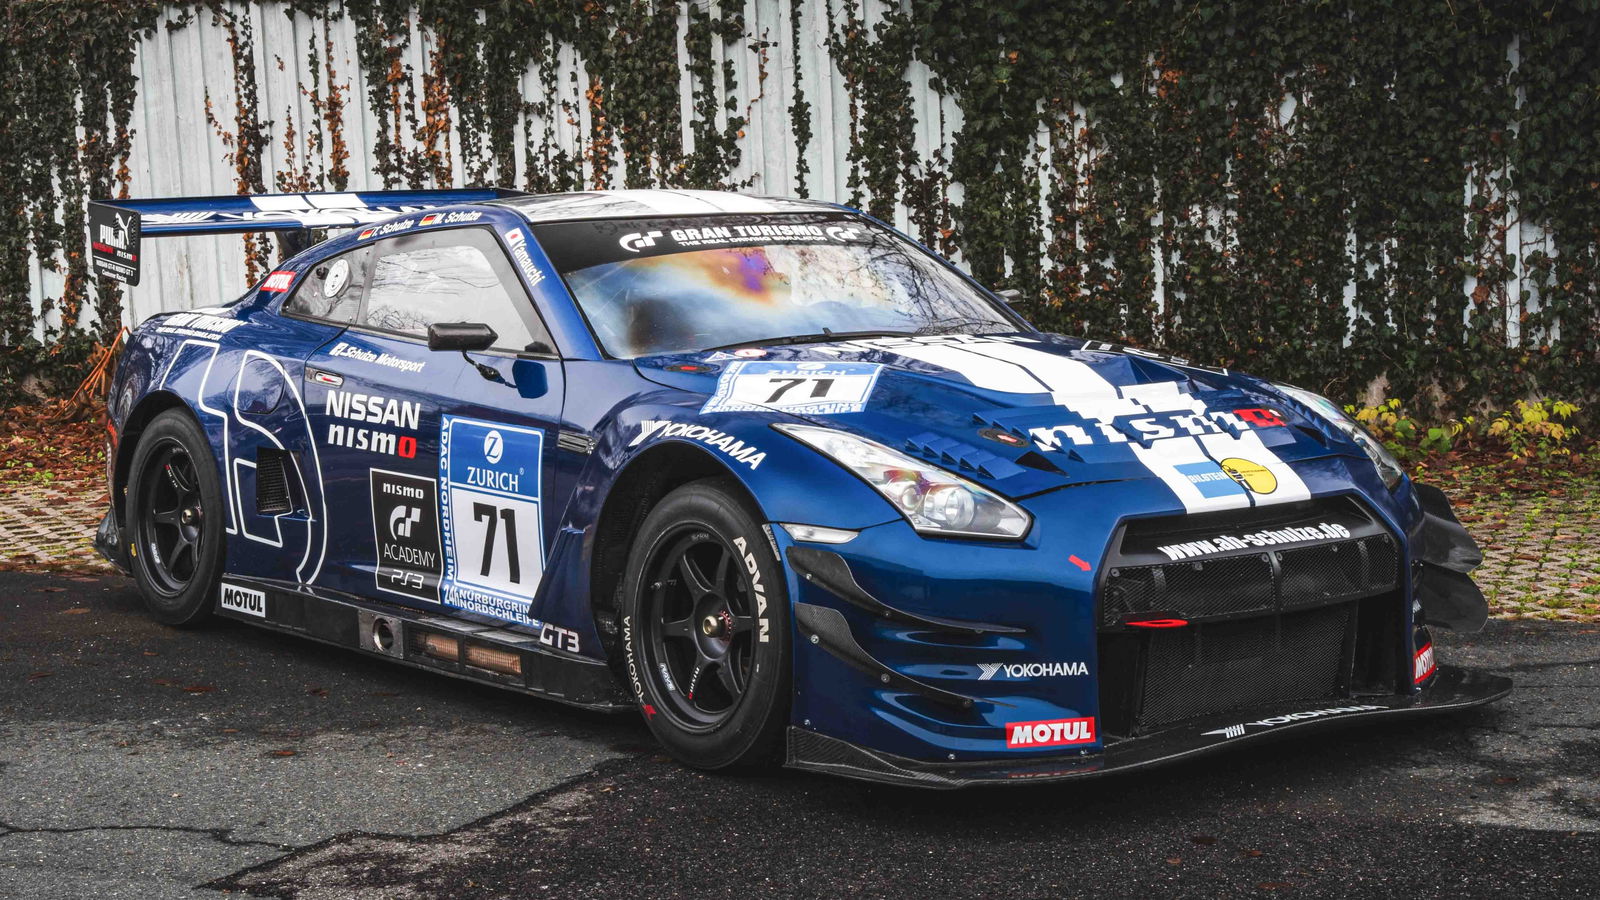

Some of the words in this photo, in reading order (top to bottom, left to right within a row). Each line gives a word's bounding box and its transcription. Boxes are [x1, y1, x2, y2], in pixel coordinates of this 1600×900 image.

[381, 220, 414, 234] Schulze
[445, 211, 482, 223] Schulze
[671, 227, 731, 242] GRAN
[733, 224, 824, 238] TURISMO
[771, 234, 828, 242] SIMULATOR
[512, 239, 546, 287] Yamauchi
[375, 353, 426, 373] Motorsport
[764, 378, 835, 404] 71
[325, 390, 421, 431] NISSAN
[328, 424, 417, 459] nismo
[440, 416, 450, 469] ADAC
[1029, 408, 1287, 452] nismo
[657, 421, 767, 470] YOKOHAMA
[383, 483, 424, 499] nismo
[467, 466, 519, 493] ZURICH
[441, 475, 455, 581] NORDHEIM
[473, 501, 521, 585] 71
[1157, 522, 1350, 561] www.ah-schulze.de
[384, 543, 436, 568] ACADEMY
[391, 569, 424, 589] PS3
[733, 536, 769, 643] ADVAN
[224, 588, 262, 612] MOTUL
[444, 584, 460, 606] 24h
[459, 588, 529, 614] NÜRBURGRIN
[459, 599, 539, 627] NORDSCHLEIFE
[540, 624, 579, 653] GT3
[623, 615, 644, 702] YOKOHAMA
[1003, 662, 1089, 678] YOKOHAMA
[1011, 721, 1091, 745] MOTUL
